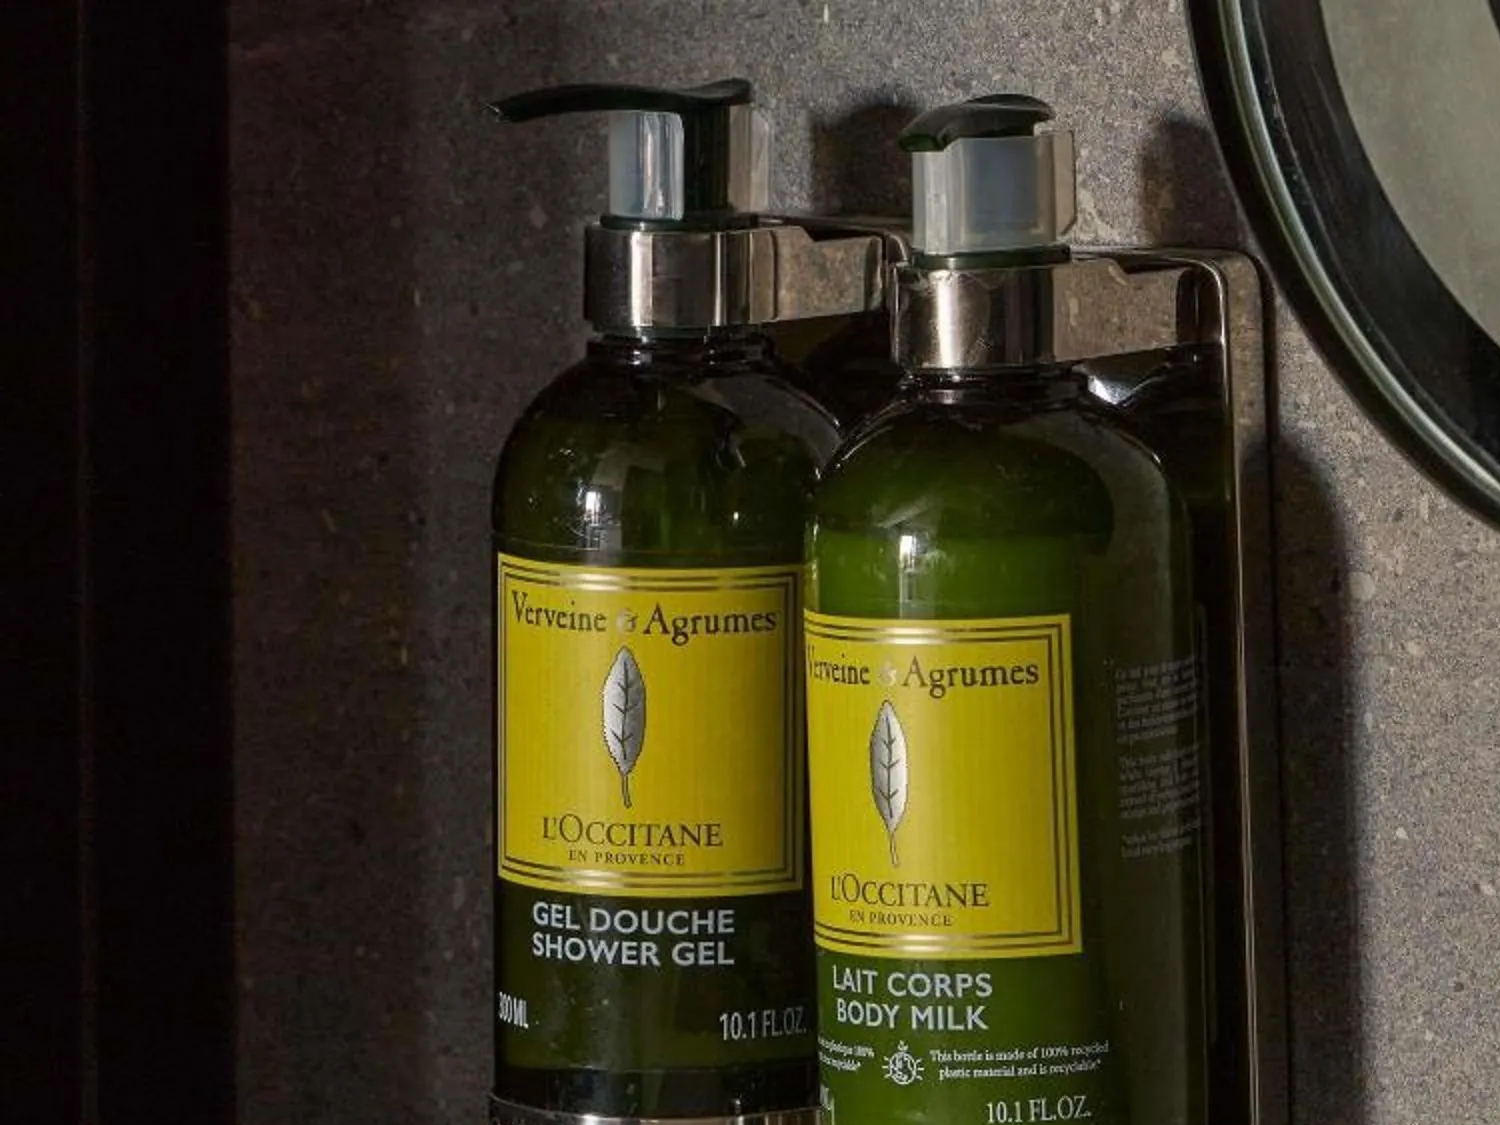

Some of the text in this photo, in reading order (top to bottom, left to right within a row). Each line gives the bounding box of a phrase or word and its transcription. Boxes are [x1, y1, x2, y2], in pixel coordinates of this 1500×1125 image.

[511, 589, 607, 633] Verveine
[642, 603, 778, 647] Agrumes
[901, 655, 1040, 699] Agrumes
[568, 849, 686, 866] EN PROVENCE
[532, 901, 736, 935] GEL DOUCHE
[849, 910, 953, 927] EN PROVENCE
[532, 932, 735, 967] SHOWER GEL
[832, 964, 993, 998] LAIT CORPS
[719, 1010, 756, 1040] 10.1
[837, 999, 989, 1031] BODY MILK
[929, 1040, 1109, 1061] This bottle is made of 100% recycled
[938, 1065, 971, 1080] plastic
[973, 1066, 1015, 1078] material
[1017, 1063, 1037, 1076] and
[1039, 1063, 1049, 1075] is
[986, 1095, 1092, 1125] 10.1 FL.OZ.
